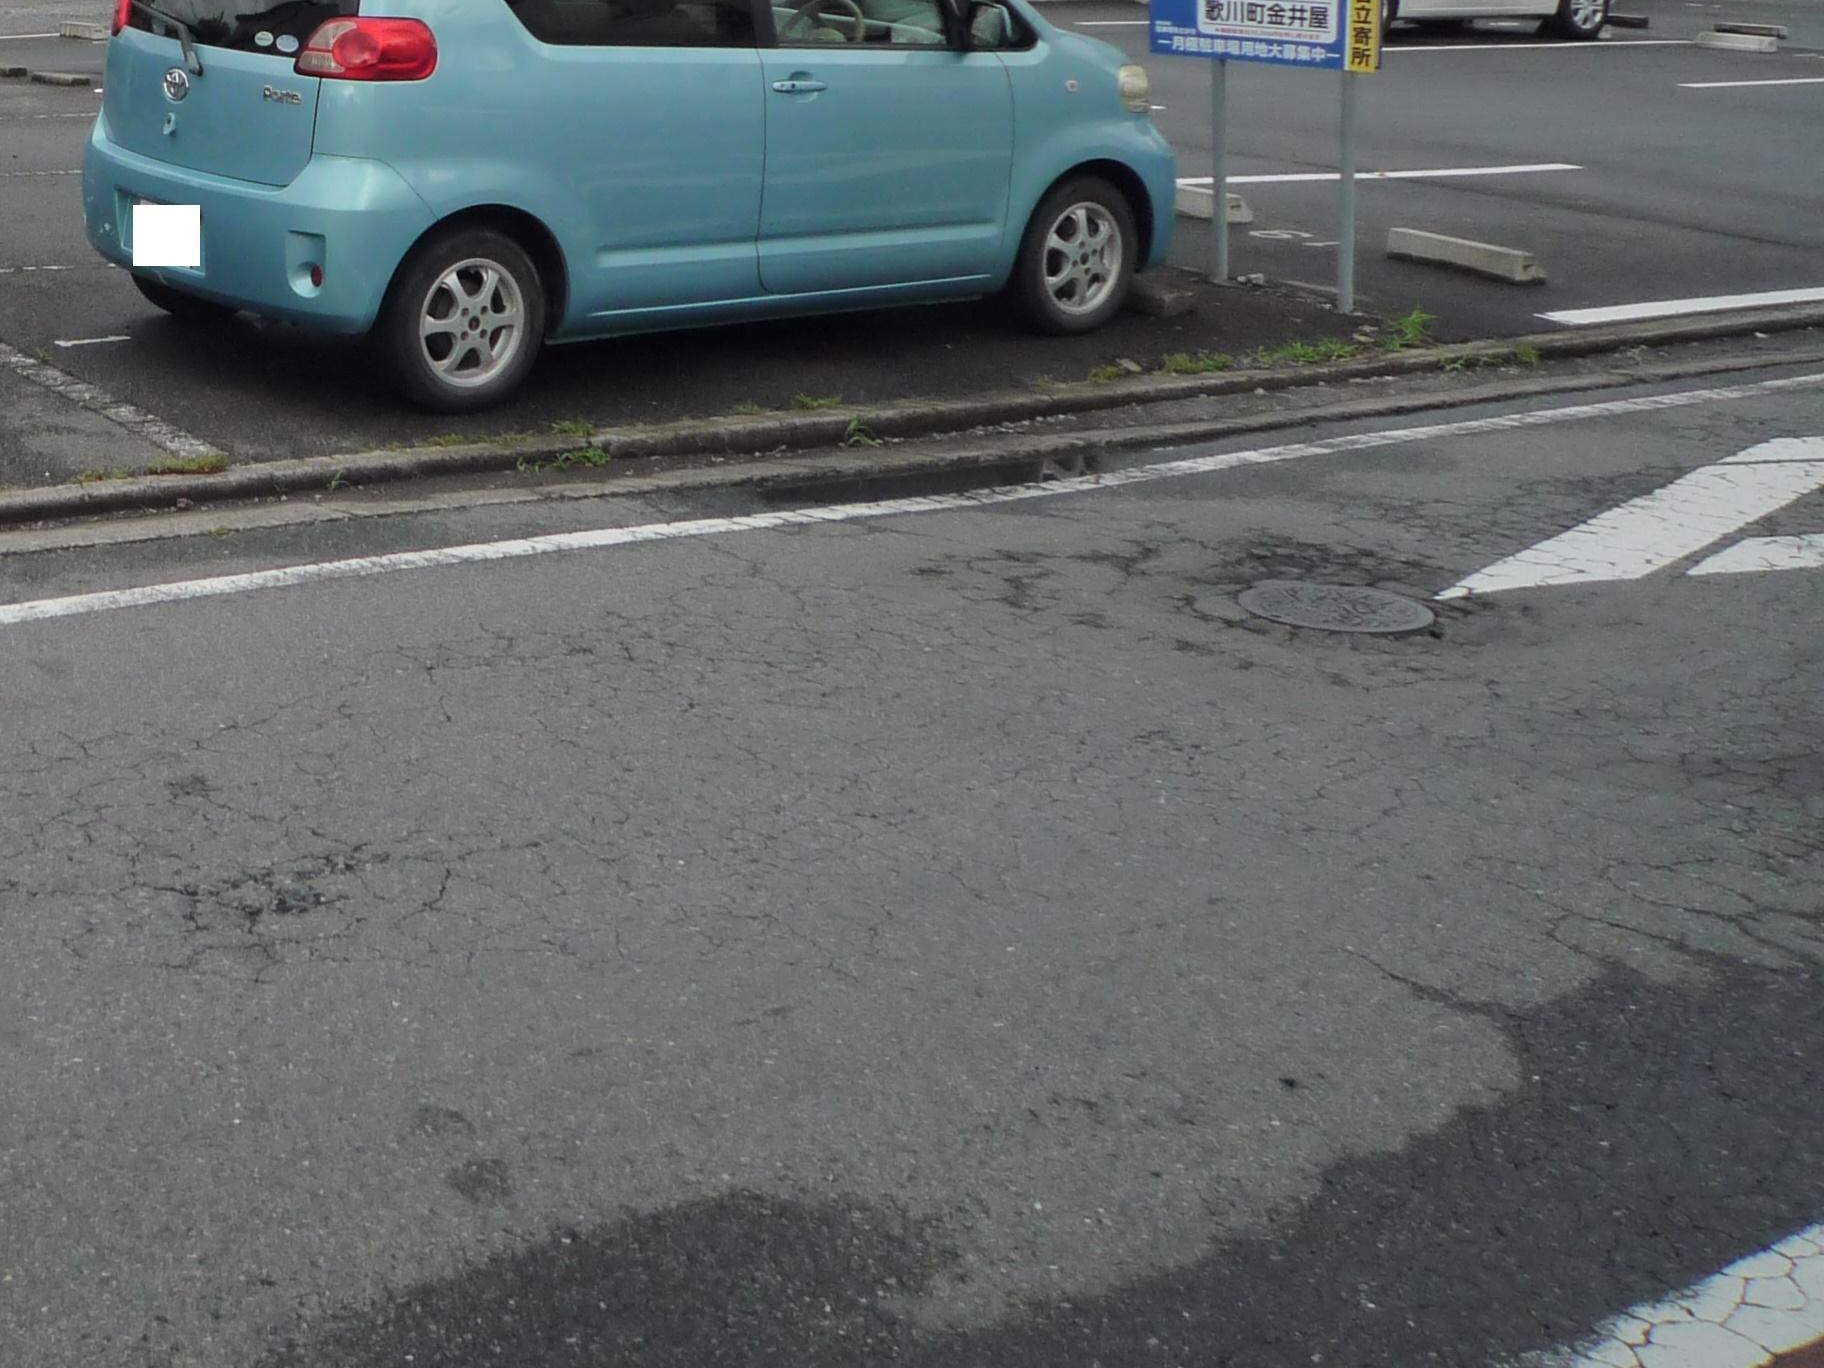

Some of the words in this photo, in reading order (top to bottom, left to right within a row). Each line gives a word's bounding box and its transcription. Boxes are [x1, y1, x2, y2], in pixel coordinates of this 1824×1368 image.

[1205, 0, 1329, 29] 歌川町金井屋
[263, 85, 302, 104] Porte
